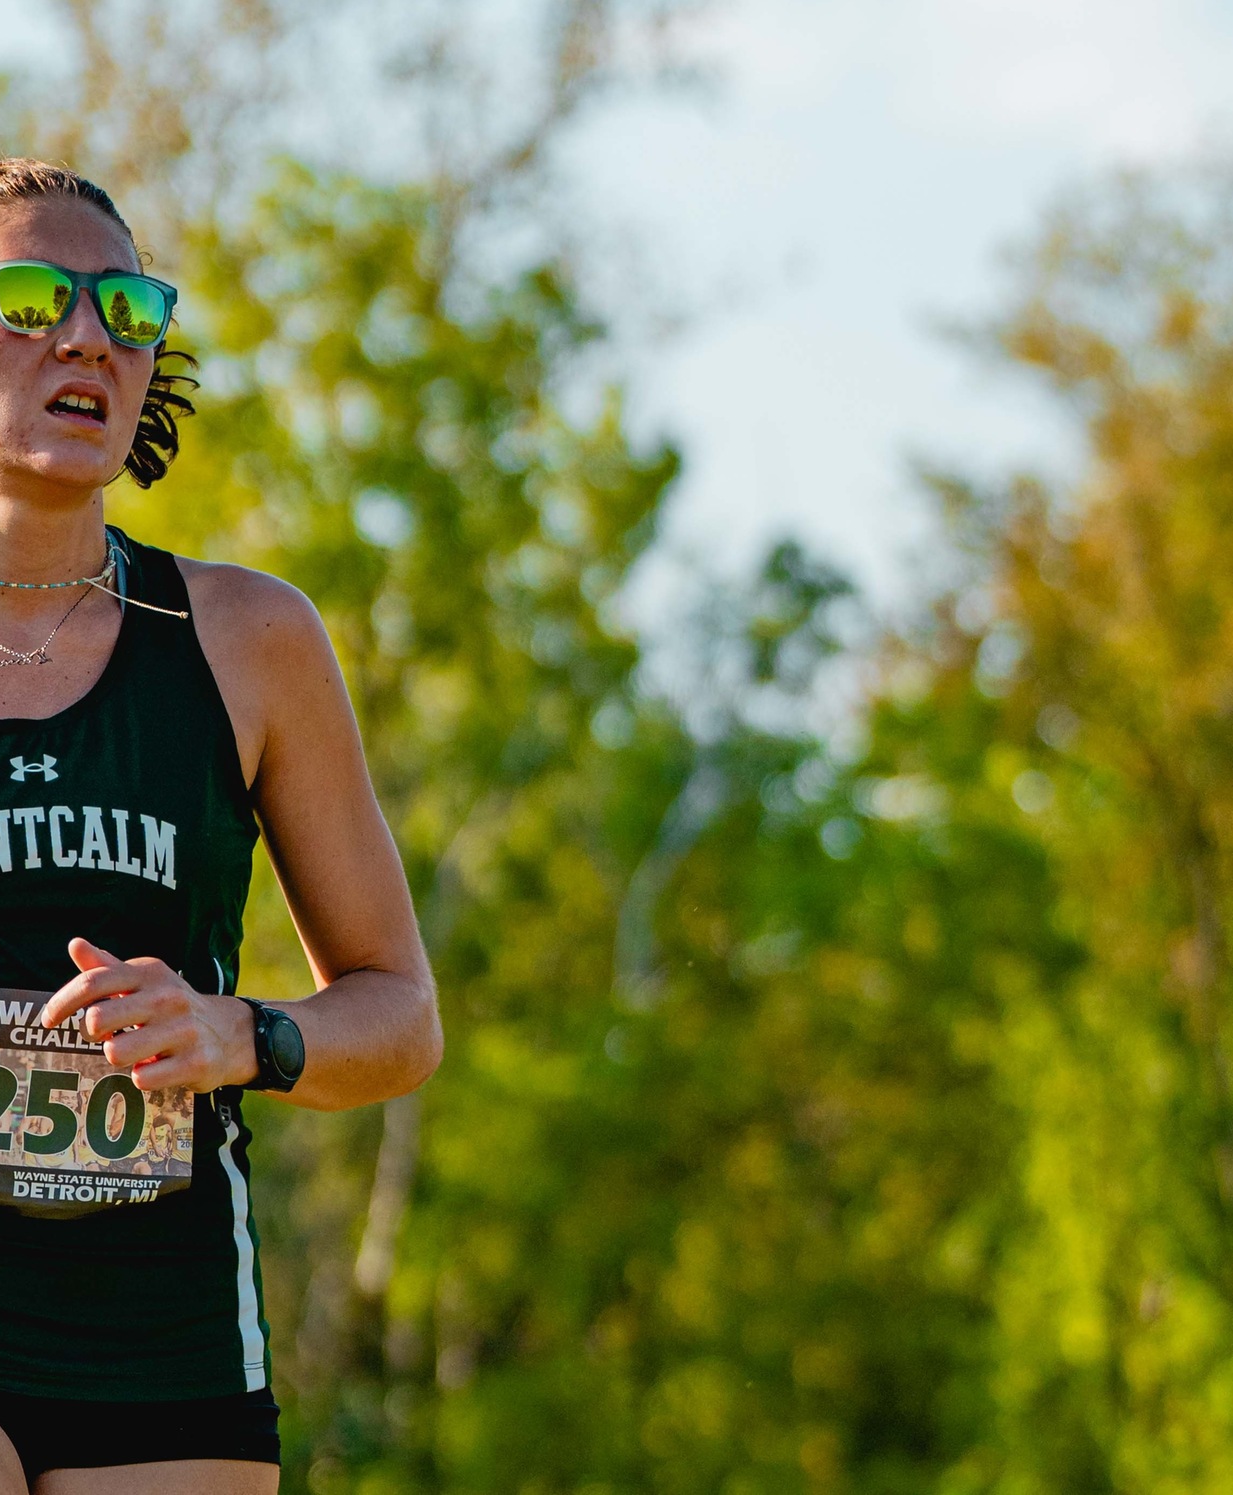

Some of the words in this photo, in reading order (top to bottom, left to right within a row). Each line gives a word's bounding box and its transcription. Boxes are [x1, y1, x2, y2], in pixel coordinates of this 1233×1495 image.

[13, 1171, 56, 1183] WAYNE
[57, 1174, 93, 1186] STATE
[95, 1177, 163, 1189] UNIVERSITY
[13, 1180, 123, 1206] DETROIT,
[128, 1189, 159, 1204] MI
